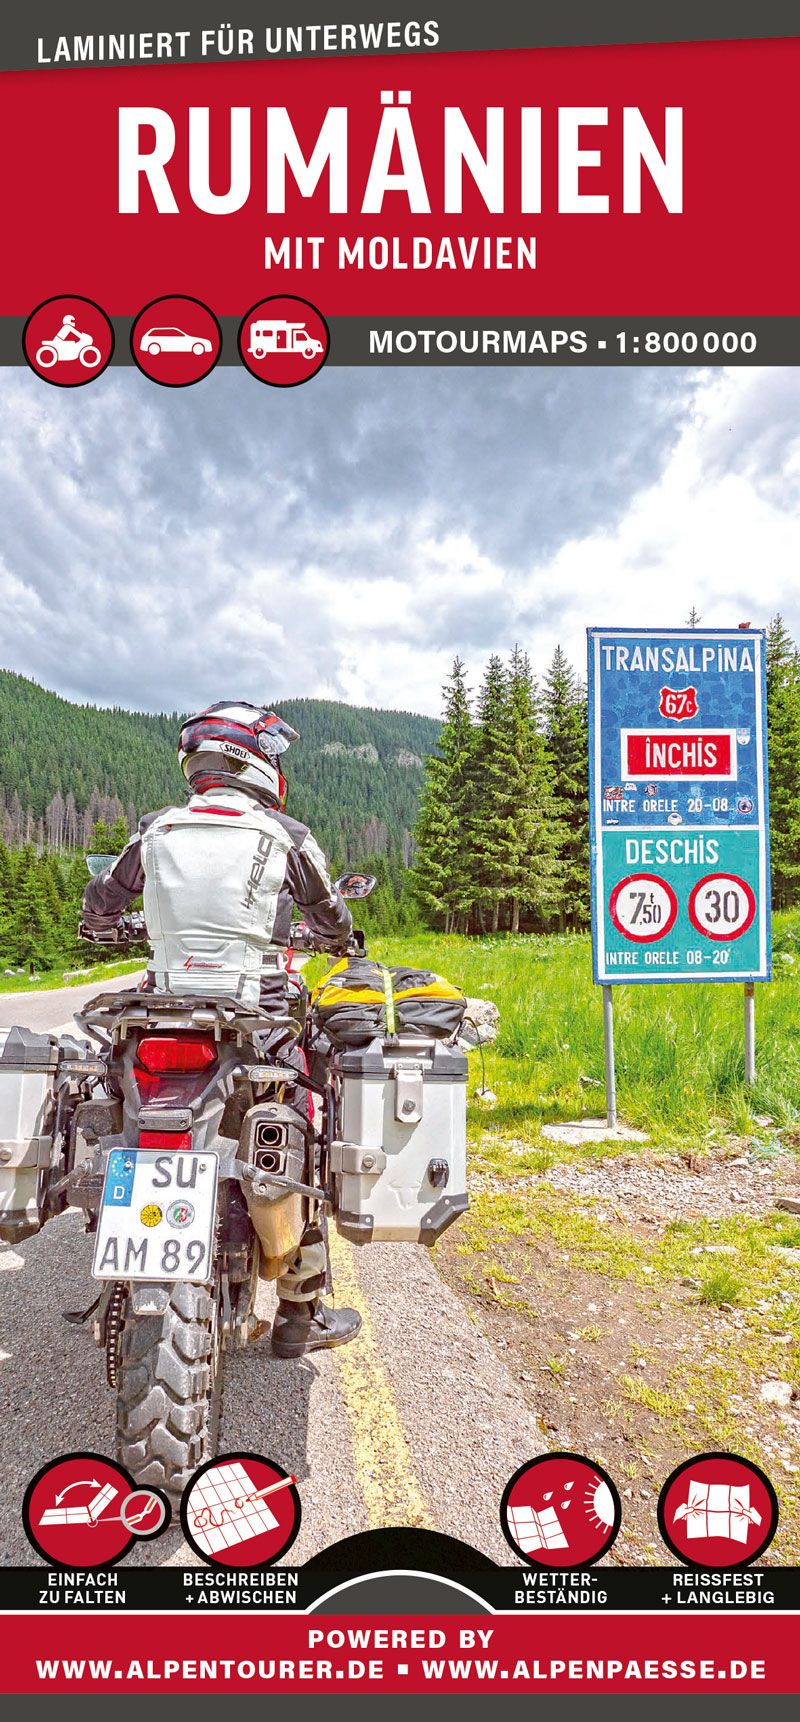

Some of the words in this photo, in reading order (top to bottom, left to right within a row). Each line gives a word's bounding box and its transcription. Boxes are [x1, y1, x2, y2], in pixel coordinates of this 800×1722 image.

[224, 744, 247, 759] SHOEI
[603, 799, 635, 812] INTRE
[643, 799, 678, 812] ORELE
[704, 890, 740, 923] 30
[605, 951, 638, 965] INTRE
[644, 951, 679, 965] ORELE
[152, 1156, 199, 1188] SU
[112, 1185, 125, 1200] D
[99, 1236, 149, 1272] AM
[161, 1239, 206, 1274] 89
